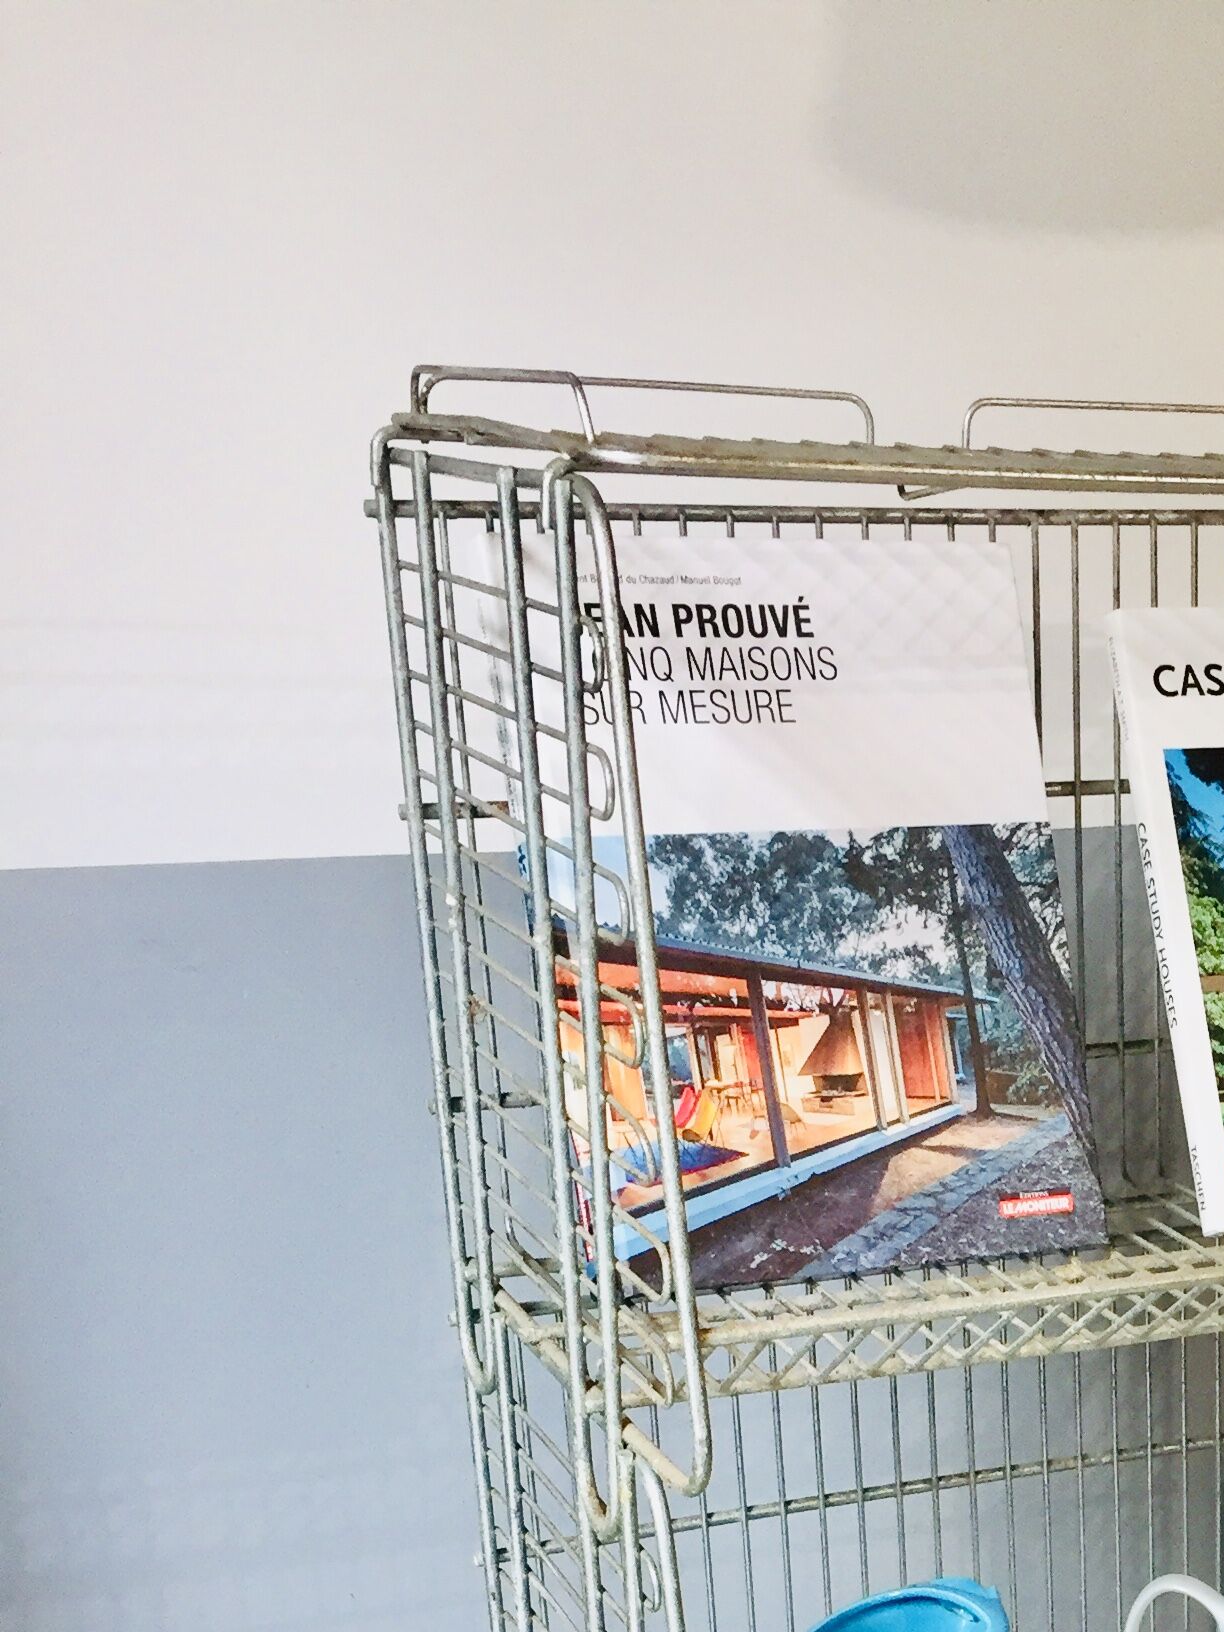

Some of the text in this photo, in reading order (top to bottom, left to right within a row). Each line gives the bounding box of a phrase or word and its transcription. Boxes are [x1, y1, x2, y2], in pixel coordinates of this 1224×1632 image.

[671, 595, 815, 638] PROUVÉ
[685, 645, 838, 681] MAISONS
[658, 688, 797, 724] MESURE
[1138, 822, 1178, 1029] CASE STUDY HOUSES
